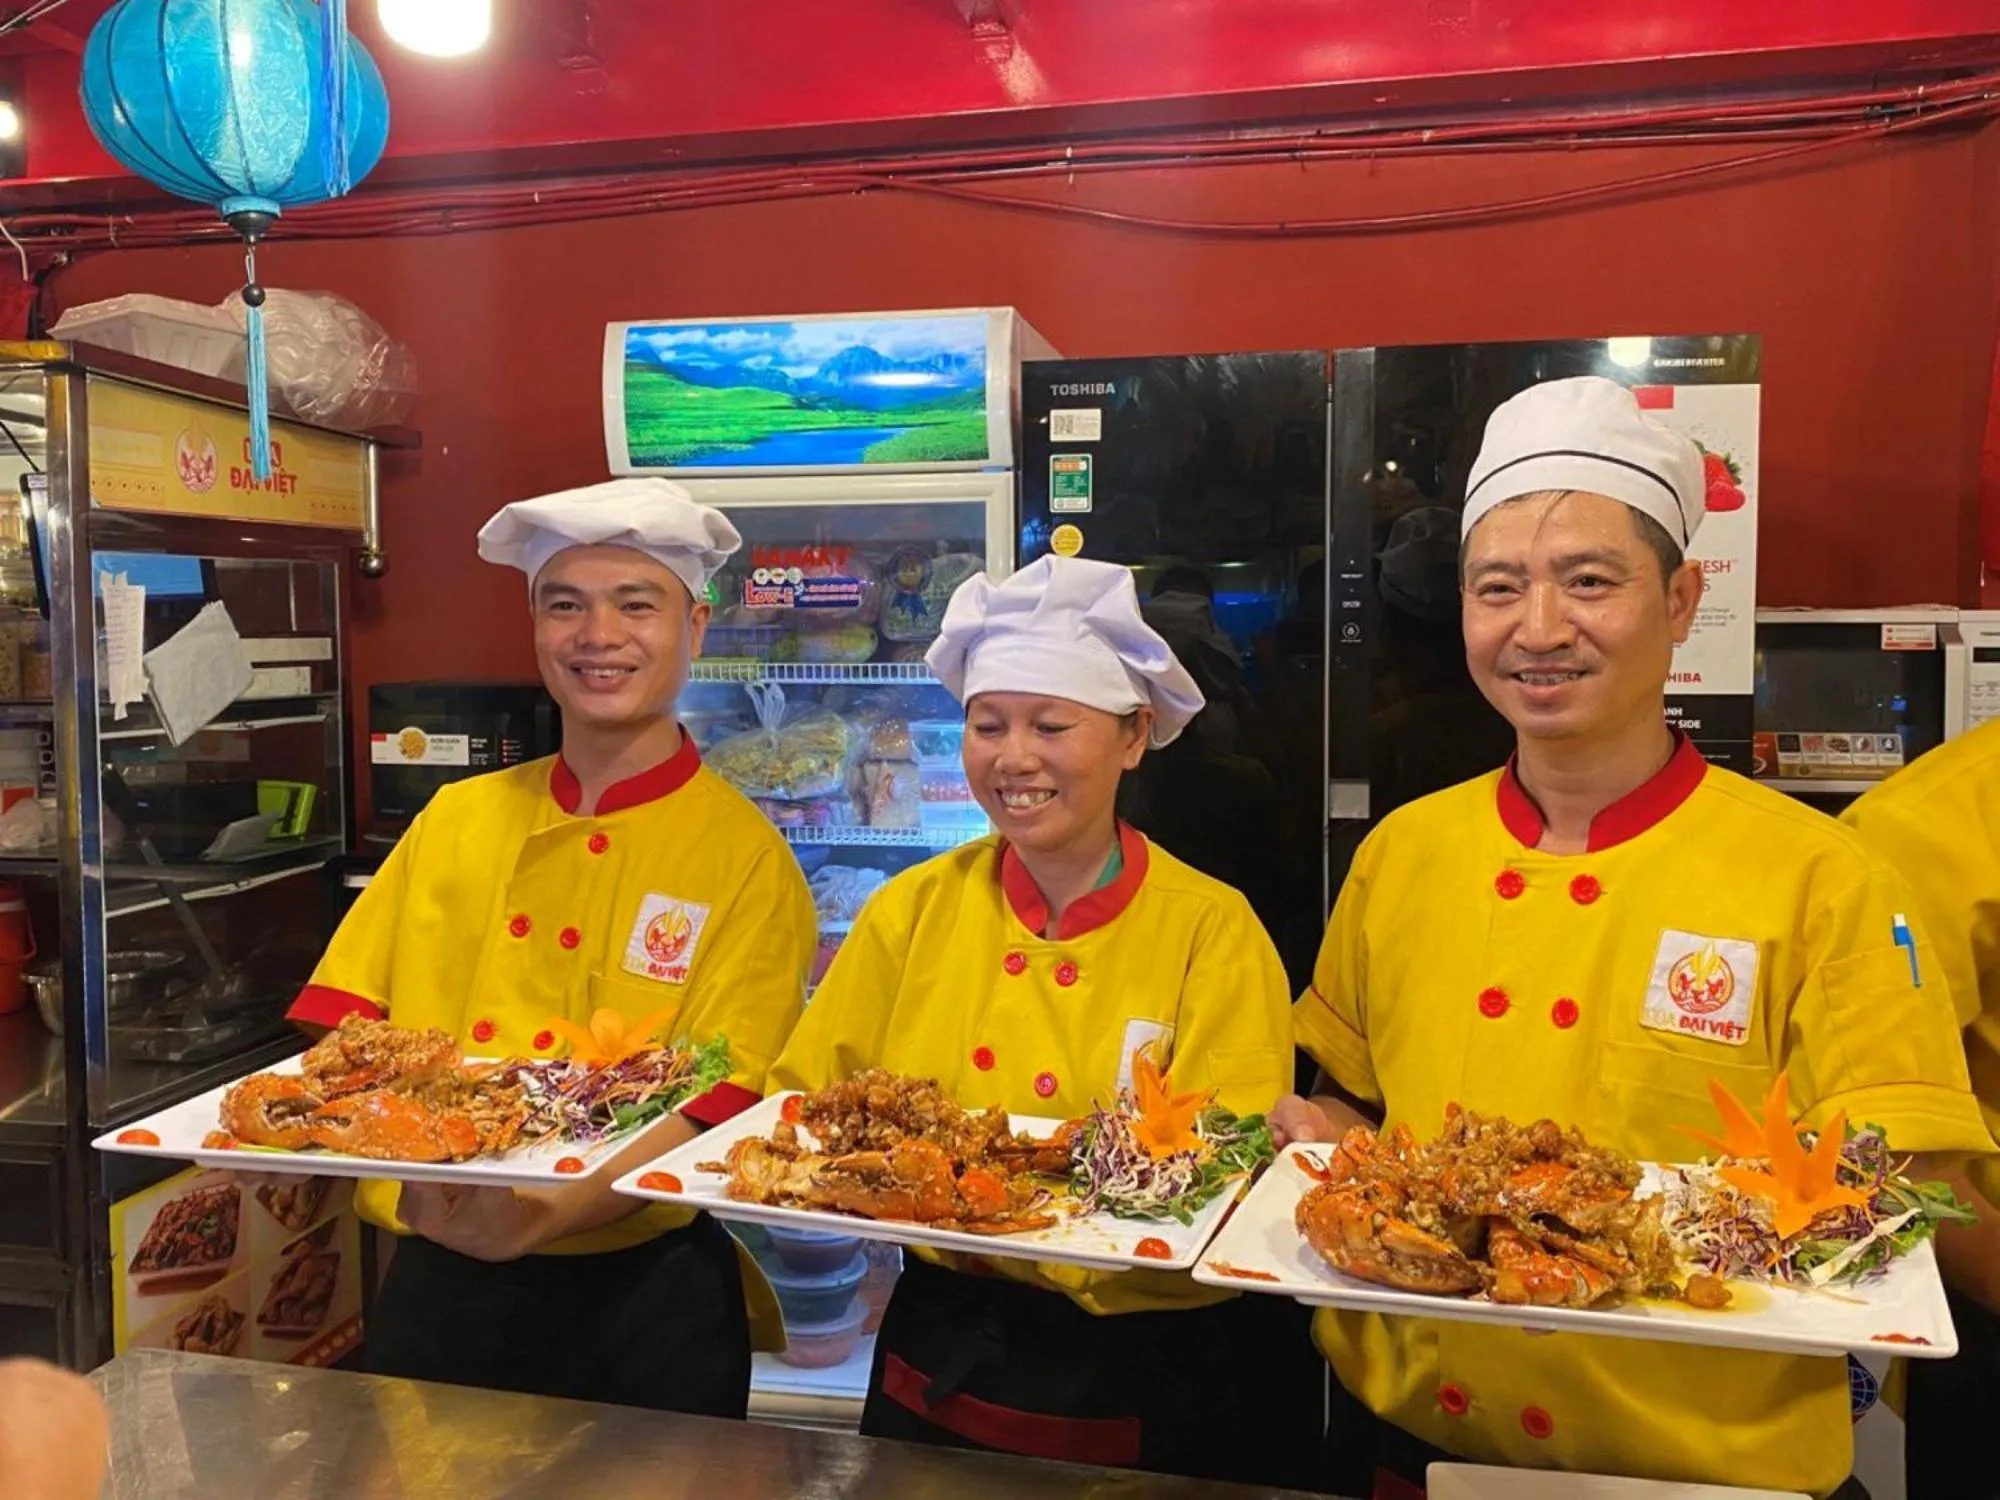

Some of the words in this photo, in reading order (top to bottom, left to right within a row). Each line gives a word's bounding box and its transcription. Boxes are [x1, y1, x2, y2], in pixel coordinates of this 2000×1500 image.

[1049, 383, 1116, 396] TOSHIBA
[1699, 560, 1731, 574] ESH
[1677, 719, 1701, 730] SIDE
